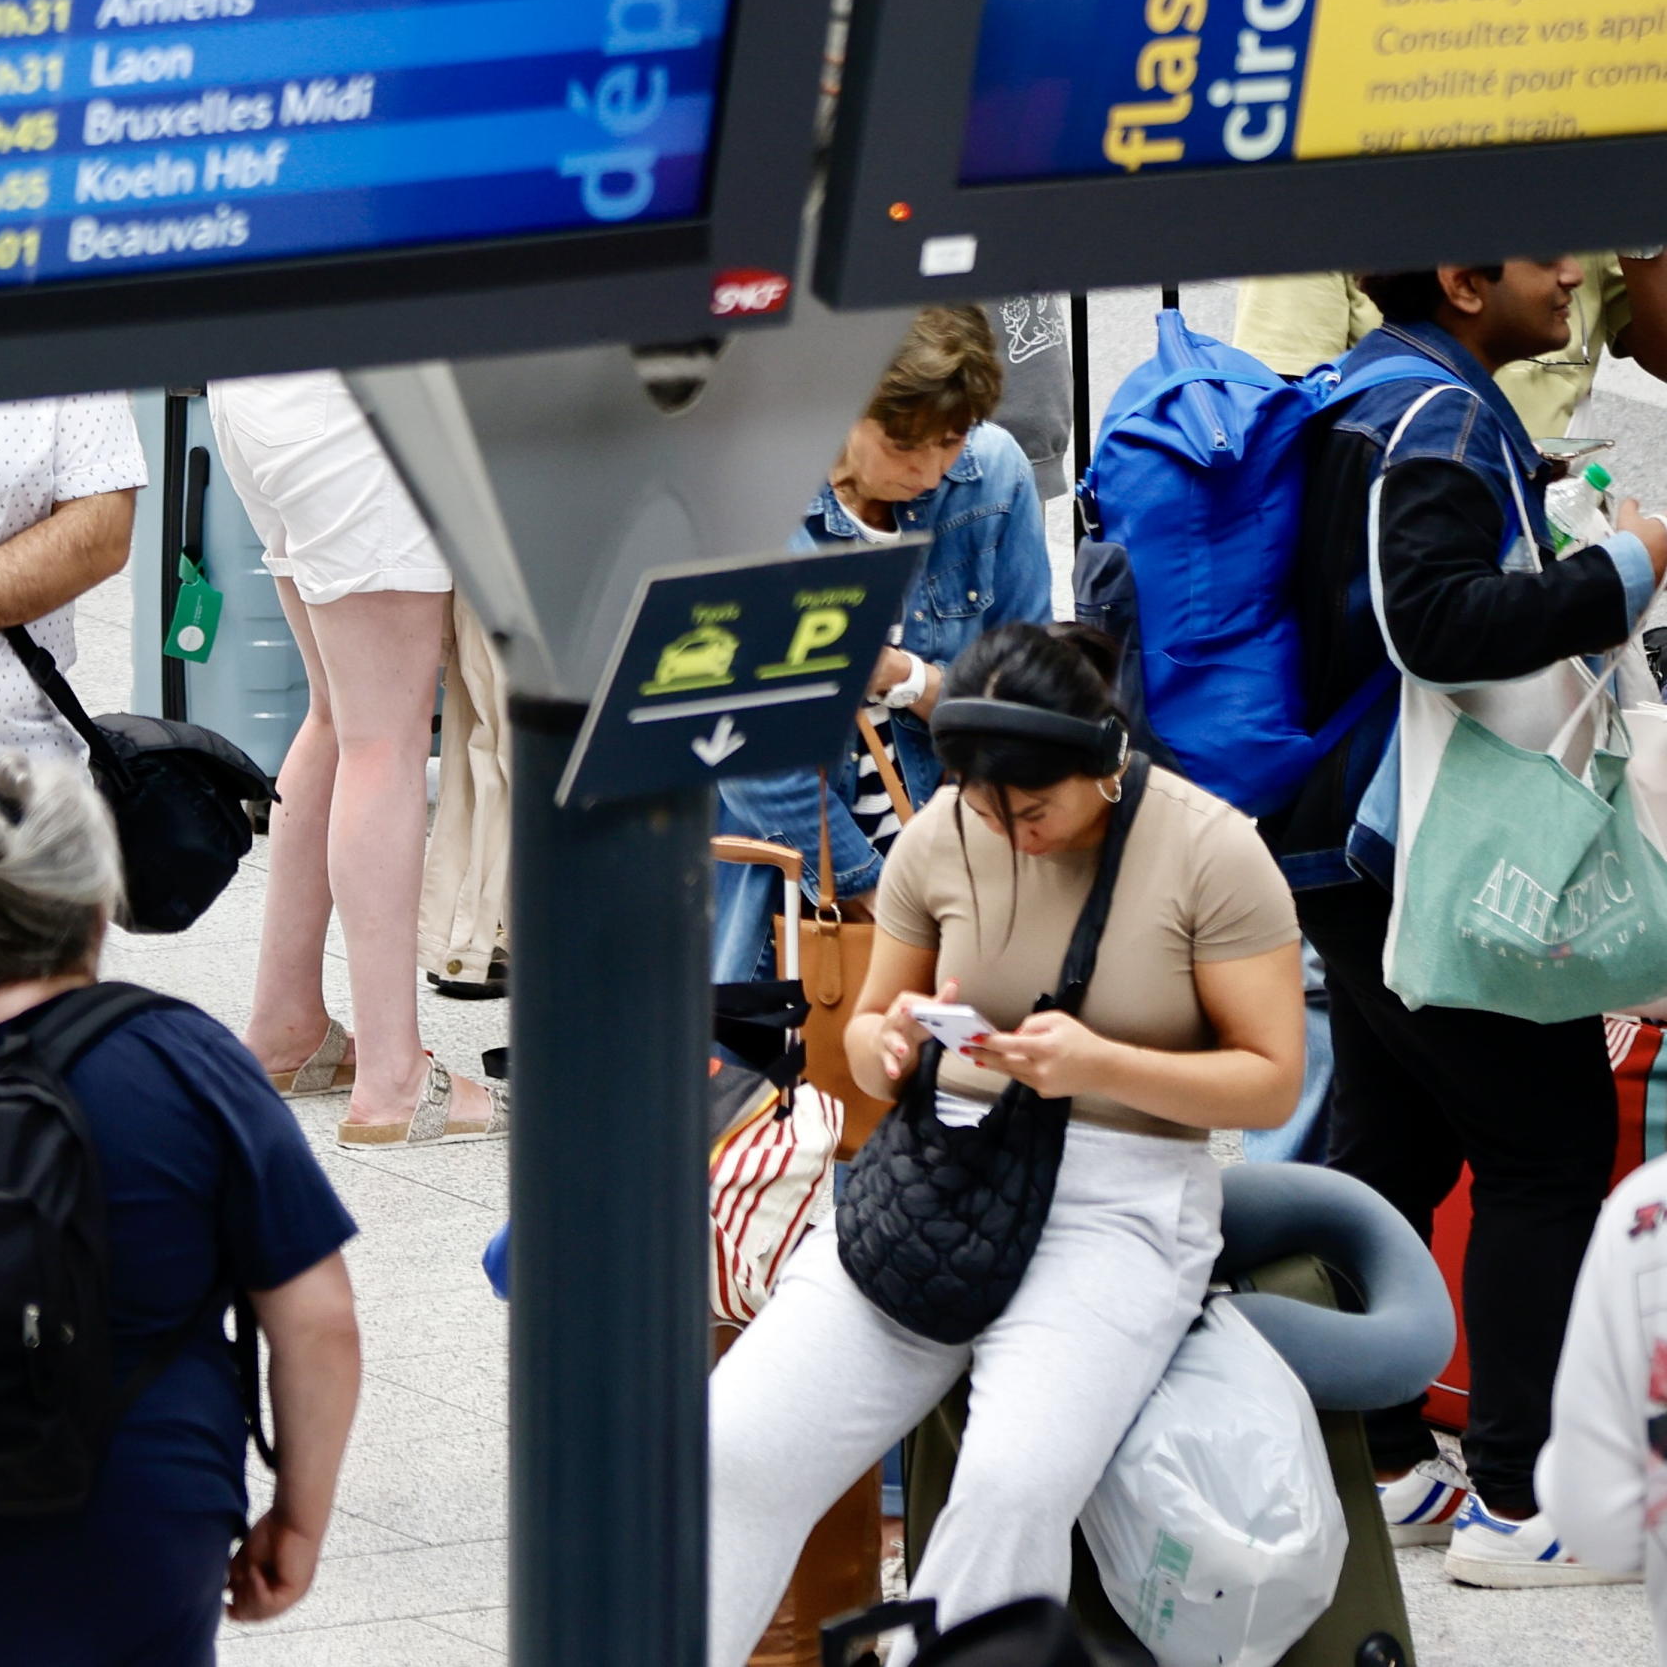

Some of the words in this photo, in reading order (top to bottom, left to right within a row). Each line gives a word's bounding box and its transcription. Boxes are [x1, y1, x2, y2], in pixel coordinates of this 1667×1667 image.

[1373, 17, 1532, 57] Consultez
[1537, 15, 1590, 43] vos
[91, 43, 195, 88] Laon
[1366, 65, 1498, 104] mobilité
[1504, 63, 1578, 100] pour
[83, 89, 275, 146] Bruxelles
[277, 73, 376, 128] Midi
[1360, 127, 1409, 155] sur
[1418, 117, 1498, 151] votre
[1503, 110, 1586, 143] train.
[75, 153, 197, 205] Koeln
[203, 138, 289, 192] Hbf
[68, 203, 251, 264] Beauvais
[786, 608, 849, 666] P
